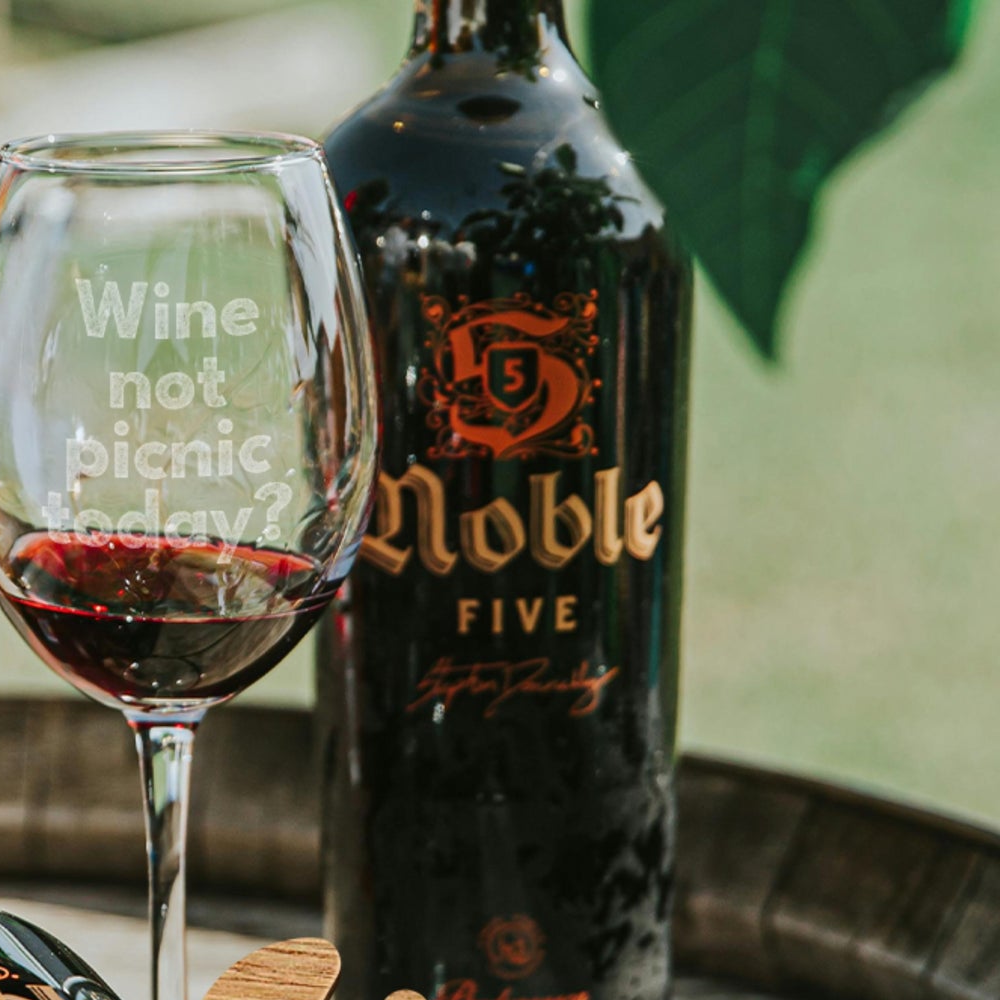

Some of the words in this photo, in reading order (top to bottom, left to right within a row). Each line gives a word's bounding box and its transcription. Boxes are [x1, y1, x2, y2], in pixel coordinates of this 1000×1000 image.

[75, 278, 260, 340] Wine
[109, 356, 228, 410] not
[502, 357, 526, 393] 5
[66, 418, 272, 493] picnic
[41, 481, 293, 564] today?
[361, 464, 665, 576] Noble
[457, 596, 579, 635] FIVE
